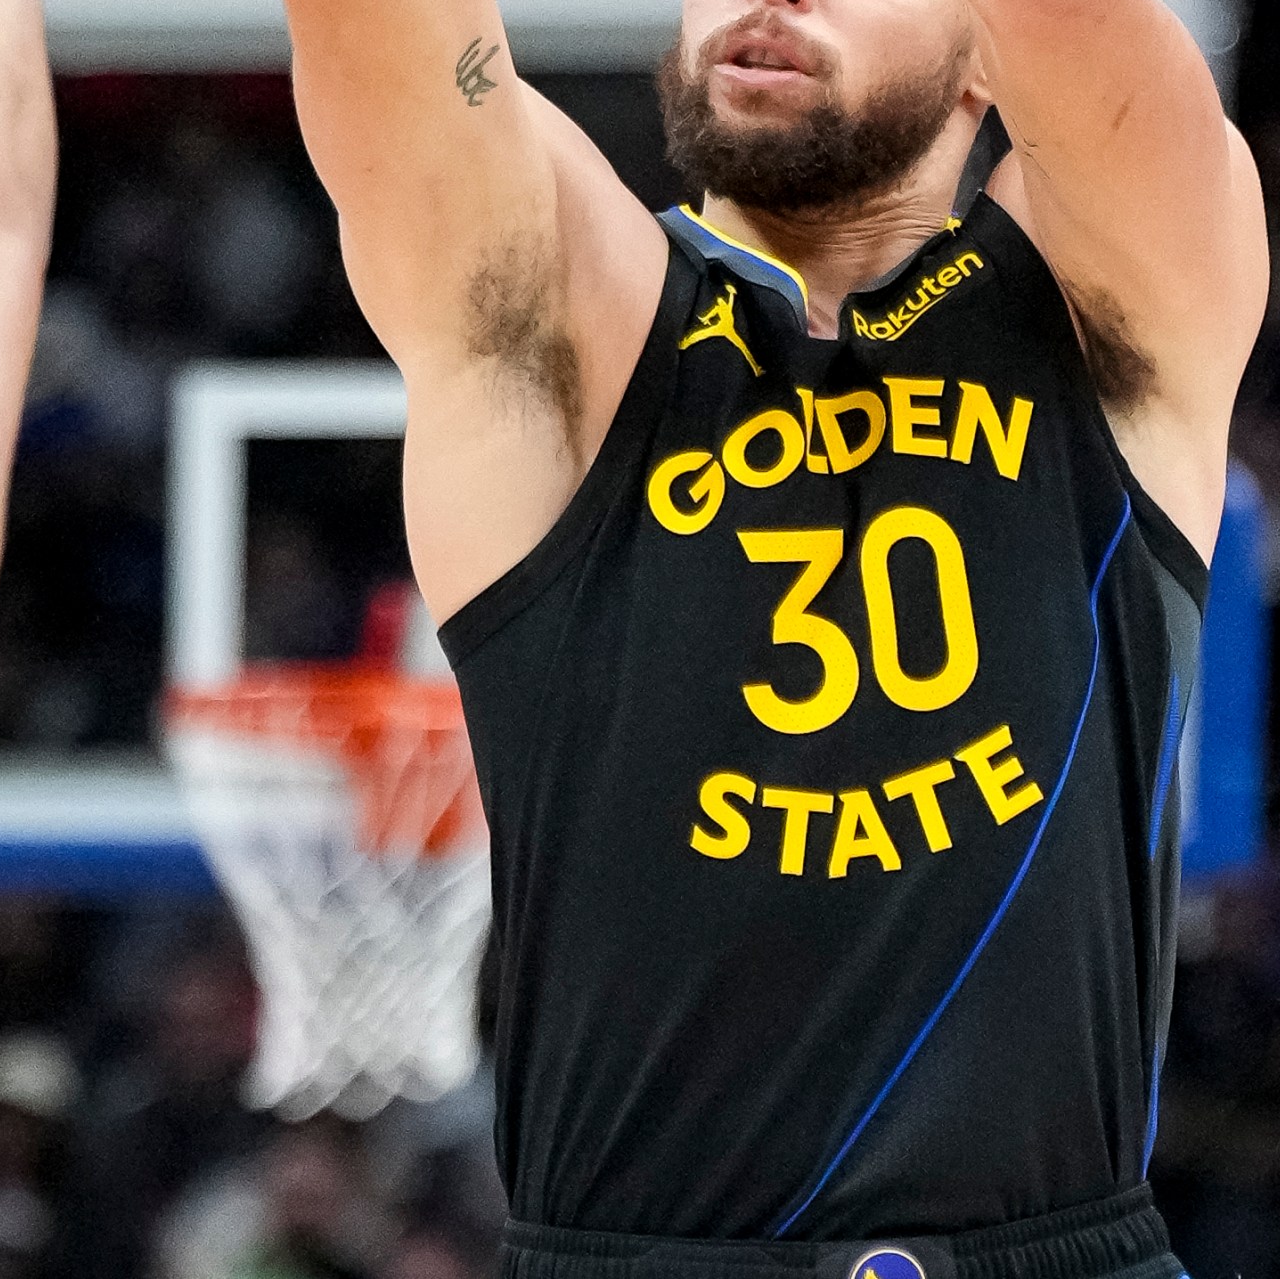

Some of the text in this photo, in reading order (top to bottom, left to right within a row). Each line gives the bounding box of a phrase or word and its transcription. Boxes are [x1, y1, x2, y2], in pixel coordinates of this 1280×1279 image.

[852, 249, 985, 342] Rakuten
[647, 375, 1034, 536] GOLDEN
[736, 506, 979, 735] 30
[689, 724, 1045, 879] STATE
